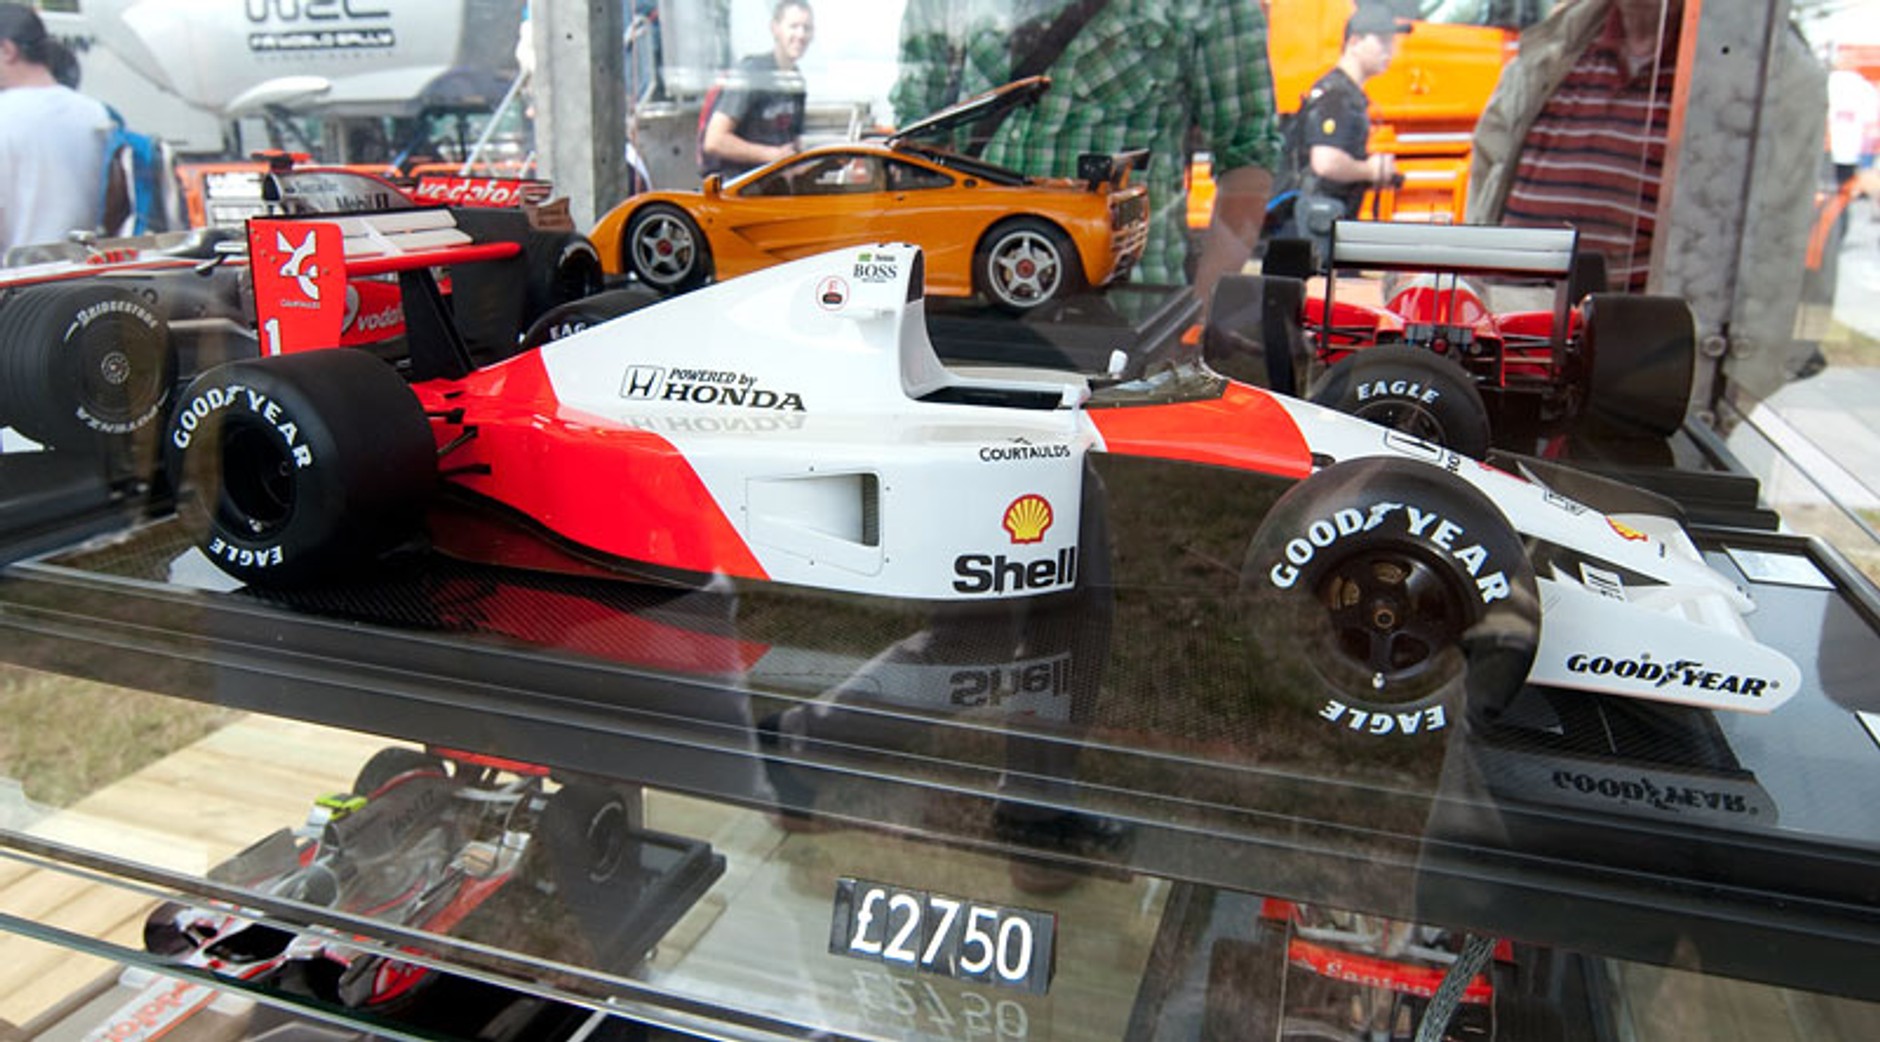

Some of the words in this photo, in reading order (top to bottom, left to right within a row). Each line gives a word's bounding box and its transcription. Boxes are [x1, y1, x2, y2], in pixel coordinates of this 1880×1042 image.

[853, 264, 898, 279] BOSS
[264, 317, 282, 356] 1
[668, 368, 738, 384] POWERED
[738, 373, 758, 387] by
[1357, 381, 1440, 404] EAGLE
[661, 383, 808, 413] HONDA
[979, 445, 1071, 463] COURTAULDS
[209, 537, 284, 567] EAGLE
[952, 546, 1076, 594] Shell
[1566, 654, 1769, 697] GOODYEAR
[1318, 700, 1447, 734] EAGLE
[850, 888, 1033, 980] £2750
